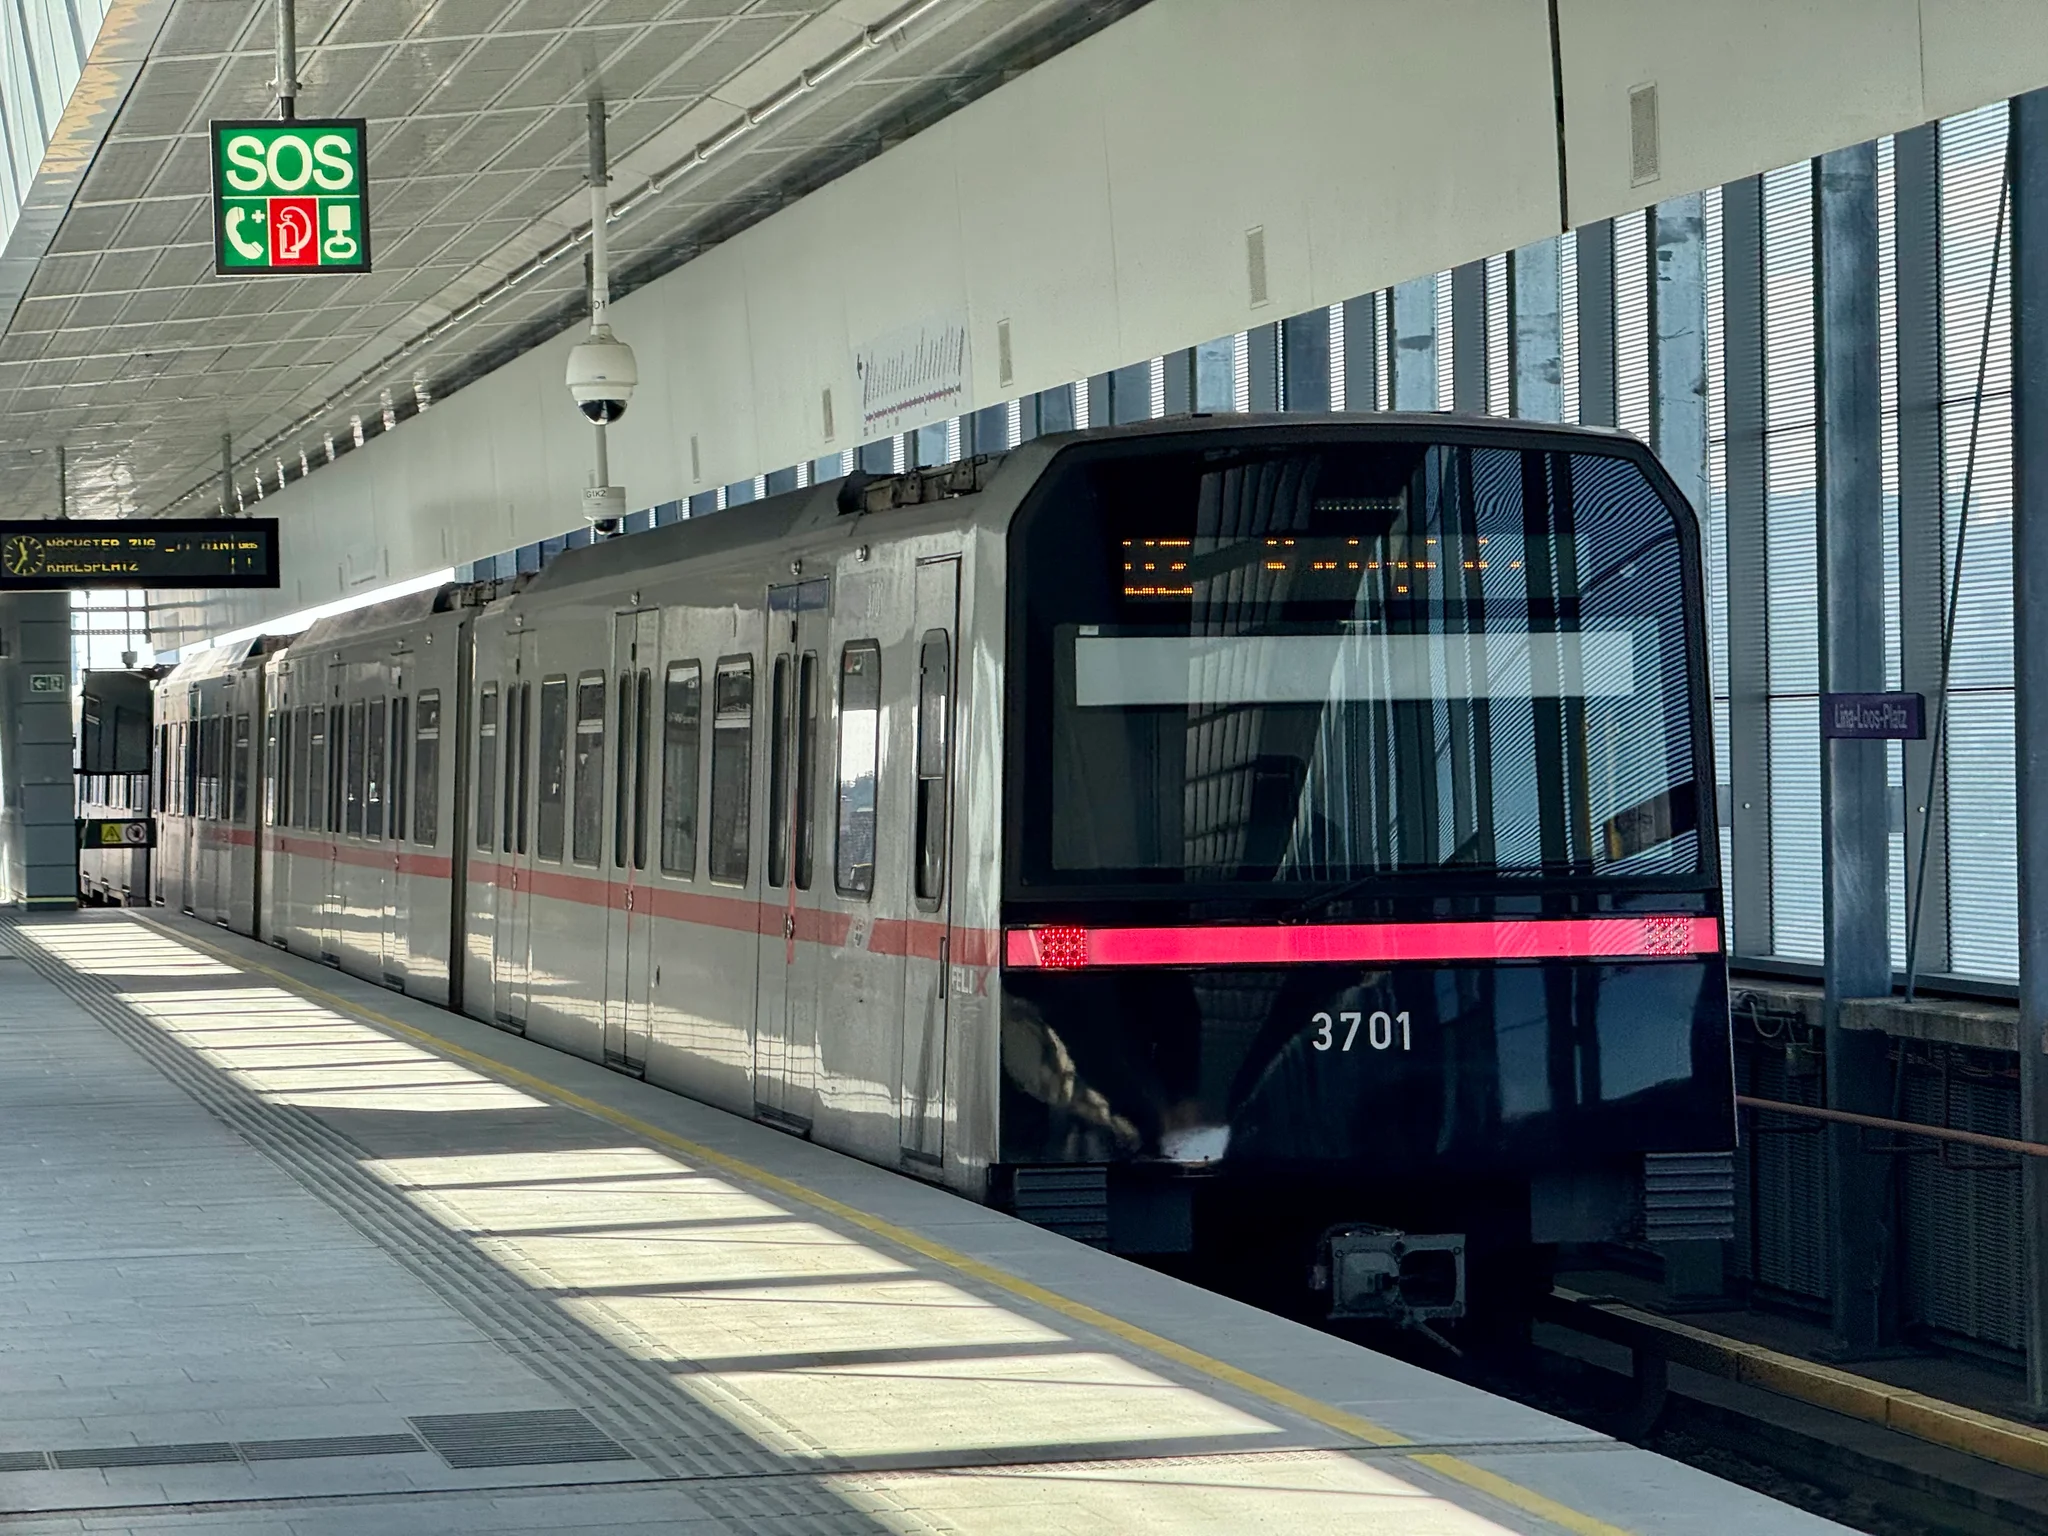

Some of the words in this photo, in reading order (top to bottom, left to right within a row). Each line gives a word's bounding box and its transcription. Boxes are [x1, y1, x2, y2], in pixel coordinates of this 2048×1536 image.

[226, 135, 354, 191] SOS
[1834, 703, 1908, 729] Lina-Loos-Platz
[1311, 1010, 1411, 1052] 3701
